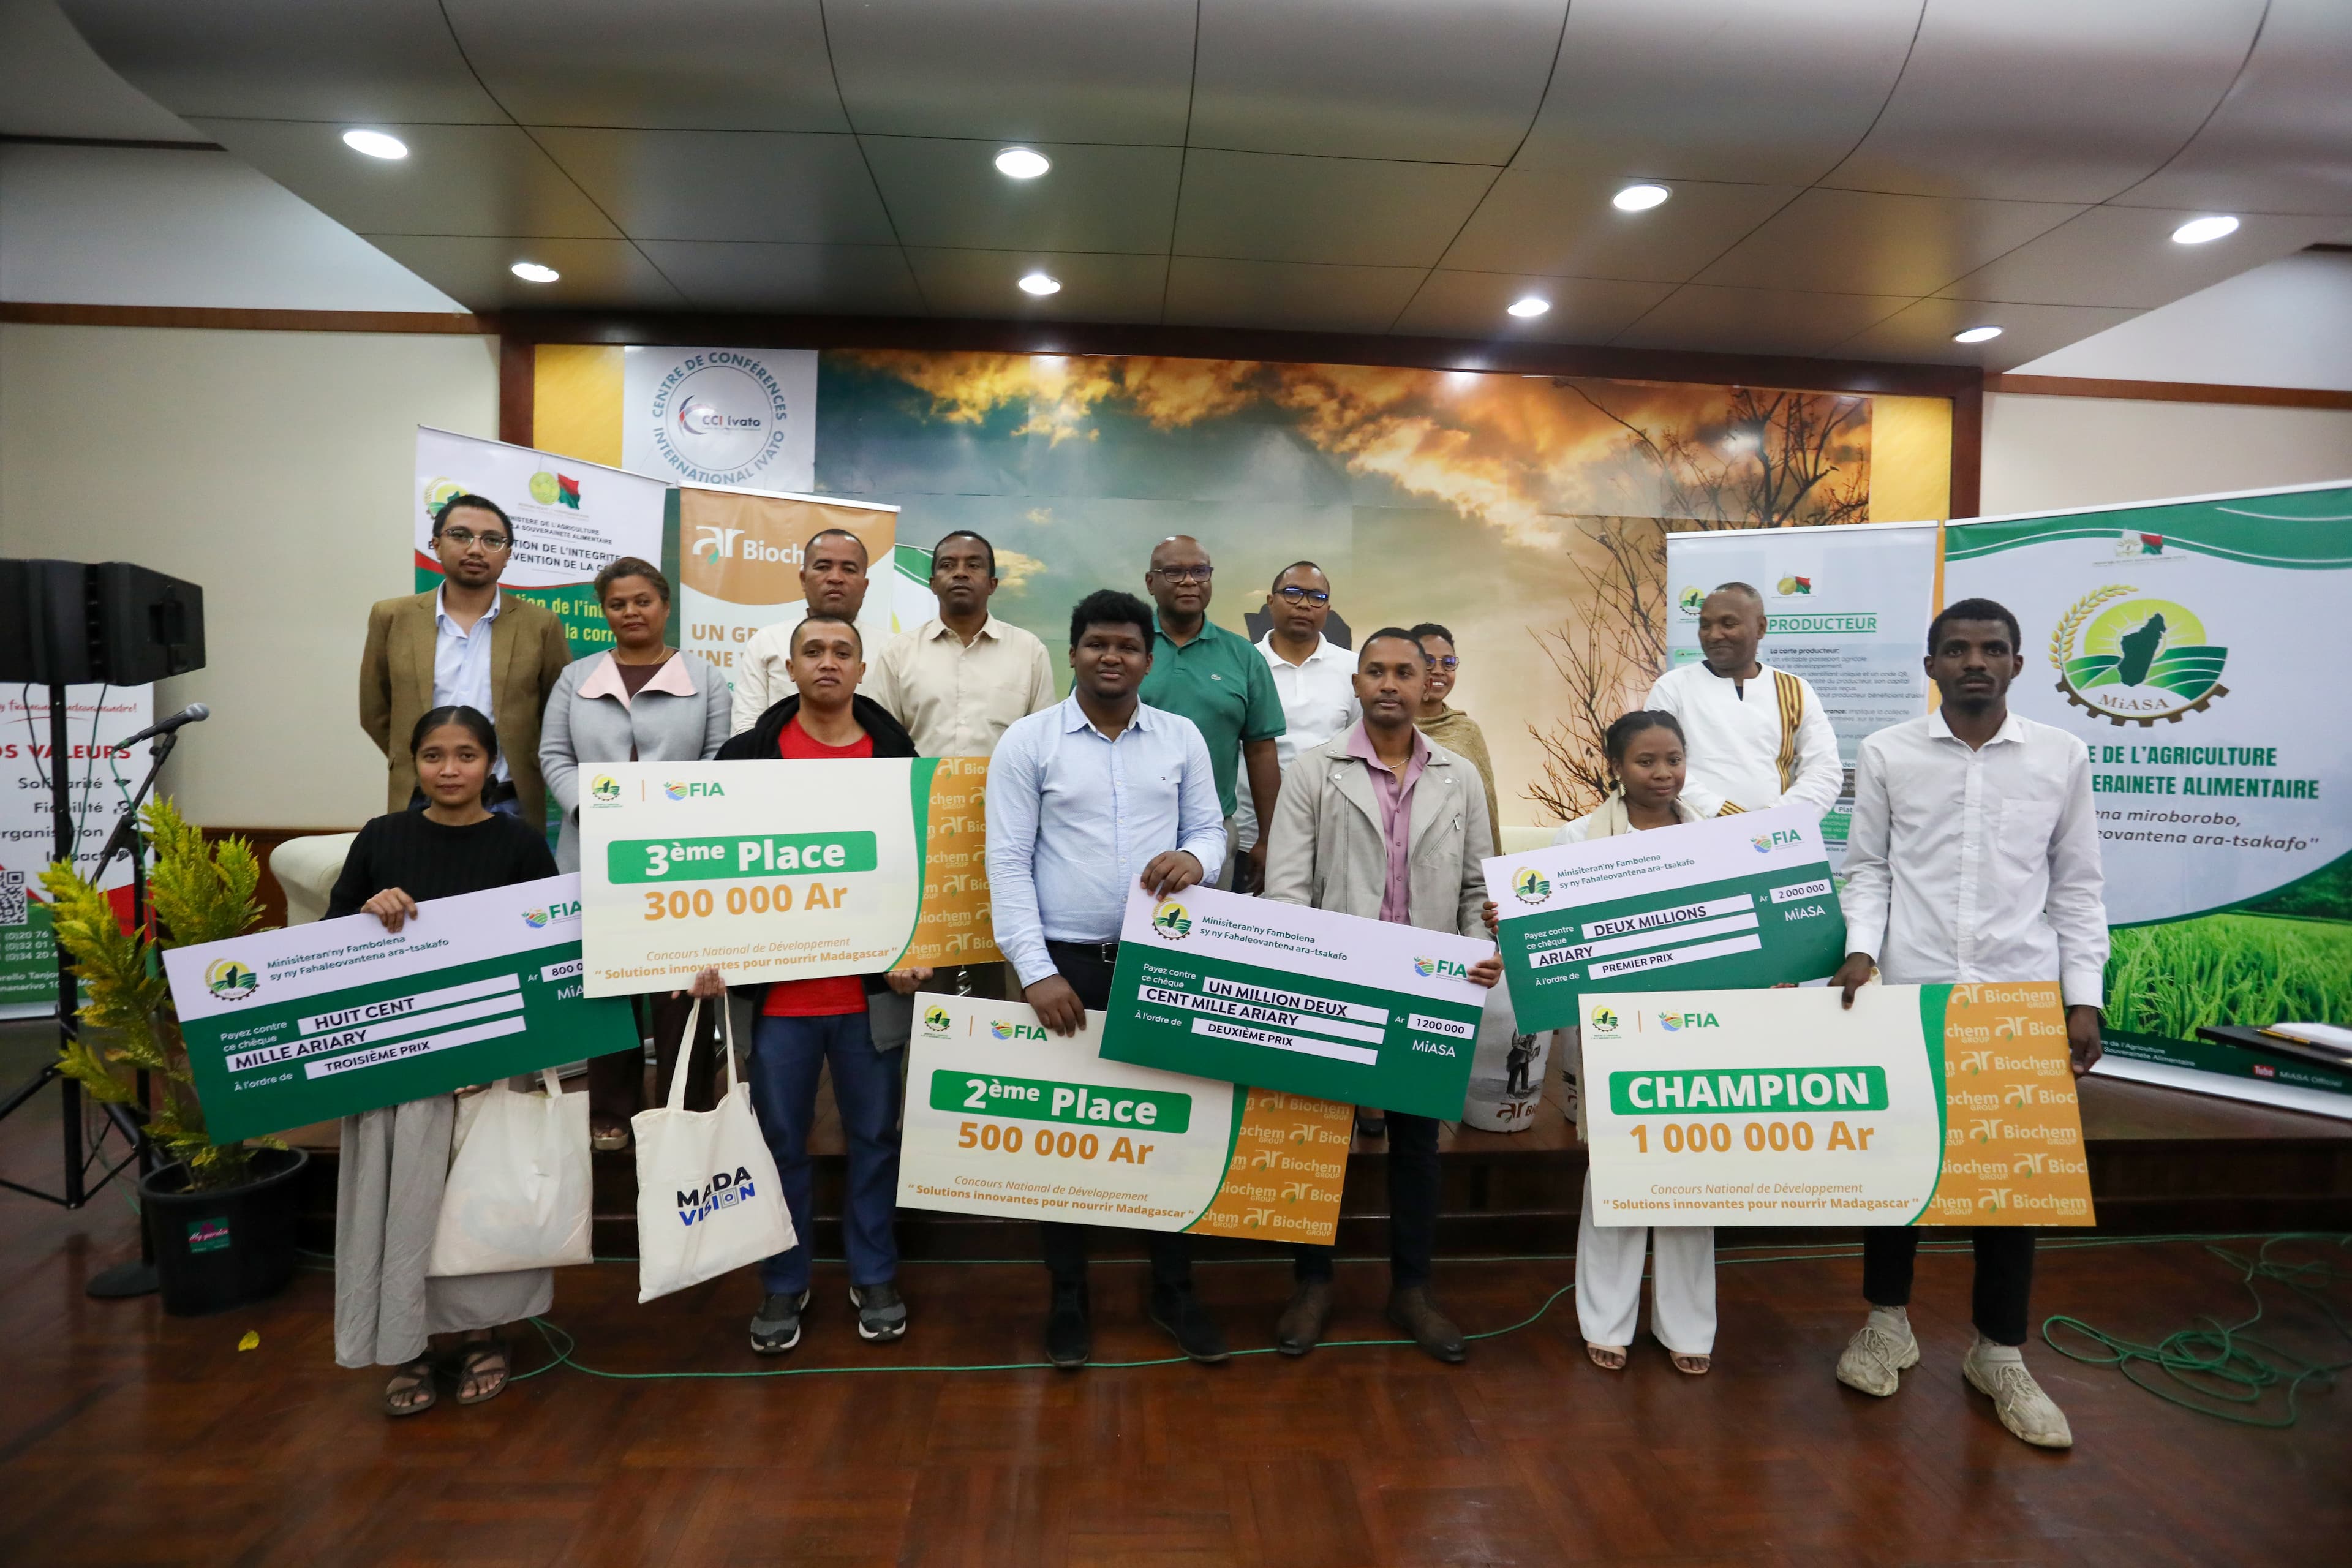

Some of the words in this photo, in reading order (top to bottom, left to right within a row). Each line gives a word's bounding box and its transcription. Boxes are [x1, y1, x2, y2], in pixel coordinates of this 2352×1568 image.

[652, 368, 684, 417] CENTRE
[684, 355, 704, 371] DE
[709, 352, 786, 420] CONFÉRENCES
[703, 415, 723, 426] CCI
[653, 427, 754, 484] INTERNATIONAL
[754, 431, 784, 470] IVATO
[522, 526, 571, 538] SOUVERAINETE
[572, 534, 612, 545] ALIMENTAIRE
[552, 522, 600, 535] L'AGRICULTURE
[543, 544, 557, 552] DE
[743, 540, 805, 564] Bioch
[564, 560, 576, 568] DE
[581, 562, 594, 571] LA
[552, 598, 569, 614] de
[565, 623, 578, 639] la
[692, 624, 724, 641] UN
[1769, 617, 1877, 631] PRODUCTEUR
[2103, 745, 2124, 764] DE
[2131, 746, 2277, 766] L'AGRICULTURE
[690, 782, 725, 797] FIA
[2092, 774, 2176, 794] ERAINETE
[2183, 777, 2320, 799] ALIMENTAIRE
[2127, 811, 2241, 827] miroborobo,
[1771, 829, 1802, 845] FIA
[644, 843, 725, 876] 3ème
[738, 839, 845, 872] Place
[1558, 864, 1615, 878] Minisiteran'ny
[1616, 854, 1661, 869] Fambolena
[1581, 867, 1646, 884] Fahaleovantena
[1648, 859, 1695, 873] ara-tsakafo
[1786, 888, 1804, 897] 000
[1807, 884, 1825, 893] 000
[549, 900, 582, 919] FIA
[644, 889, 714, 921] 300
[727, 884, 793, 915] 000
[804, 882, 848, 910] Ar
[1202, 916, 1265, 935] Minisiteran'ny
[1267, 928, 1315, 943] Fambolena
[1594, 919, 1636, 937] DEUX
[1638, 906, 1706, 929] MILLIONS
[1525, 931, 1547, 941] Payez
[1548, 925, 1574, 937] contre
[1538, 937, 1567, 949] chèque
[267, 947, 344, 969] Minisiteran'ny
[347, 935, 405, 954] Fambolena
[646, 949, 699, 962] Concours
[702, 944, 750, 957] National
[753, 942, 766, 954] de
[769, 937, 850, 955] Développement
[1225, 932, 1294, 951] Fahaleovantena
[1295, 945, 1348, 961] ara-tsakafo
[1539, 946, 1593, 966] ARIARY
[284, 970, 297, 979] ny
[300, 952, 386, 976] Fahaleovantena
[388, 938, 449, 957] ara-tsakafo
[605, 967, 666, 979] Solutions
[669, 960, 740, 974] innovantes
[744, 957, 772, 970] pour
[775, 952, 818, 965] nourrir
[820, 948, 889, 964] Madagascar
[1602, 959, 1648, 973] PREMIER
[1650, 953, 1673, 965] PRIX
[528, 973, 538, 982] Ar
[552, 966, 573, 976] 800
[1144, 963, 1167, 975] Payez
[1170, 968, 1196, 980] contre
[1437, 960, 1467, 978] FIA
[1536, 978, 1542, 986] À
[1544, 974, 1568, 984] l'ordre
[1570, 972, 1580, 981] de
[1153, 976, 1184, 988] chèque
[1208, 981, 1232, 996] UN
[1235, 986, 1300, 1009] MILLION
[1304, 998, 1348, 1017] DEUX
[1985, 989, 2056, 1003] Biochem
[315, 1009, 361, 1030] HUIT
[365, 998, 415, 1019] CENT
[1147, 989, 1189, 1006] CENT
[1192, 997, 1237, 1016] MILLE
[1239, 1006, 1298, 1026] ARIARY
[1134, 1010, 1142, 1019] À
[1143, 1012, 1169, 1024] l'ordre
[1170, 1017, 1182, 1027] de
[1444, 1023, 1464, 1034] 000
[1684, 1013, 1719, 1028] FIA
[1014, 1024, 1048, 1042] FIA
[1208, 1023, 1265, 1041] DEUXIÈME
[1268, 1035, 1293, 1046] PRIX
[235, 1046, 292, 1069] MILLE
[296, 1030, 367, 1057] ARIARY
[324, 1047, 398, 1072] TROISIÈME
[401, 1041, 430, 1055] PRIX
[1628, 1073, 1869, 1109] CHAMPION
[963, 1079, 1040, 1109] 2ème
[1051, 1087, 1158, 1125] Place
[958, 1121, 1023, 1153] 500
[1035, 1129, 1099, 1160] 000
[1109, 1137, 1154, 1165] Ar
[1630, 1124, 1648, 1153] 1
[1664, 1123, 1731, 1153] 000
[1744, 1121, 1814, 1152] 000
[1827, 1120, 1874, 1152] Ar
[1281, 1157, 1341, 1172] Biochem
[677, 1167, 752, 1207] MADA
[955, 1175, 1003, 1190] Concours
[1006, 1180, 1050, 1194] National
[1053, 1183, 1066, 1194] de
[1068, 1185, 1148, 1202] Développement
[1651, 1184, 1702, 1195] Concours
[1705, 1183, 1754, 1194] National
[1757, 1183, 1771, 1194] de
[1774, 1182, 1863, 1197] Développement
[679, 1182, 755, 1226] VISION
[916, 1185, 971, 1199] Solutions
[974, 1190, 1039, 1205] innovantes
[1042, 1198, 1069, 1209] pour
[1072, 1200, 1114, 1212] nourrir
[1116, 1203, 1186, 1219] Madagascar
[1613, 1199, 1670, 1210] Solutions
[1674, 1198, 1744, 1209] innovantes
[1748, 1200, 1777, 1212] pour
[1781, 1197, 1828, 1208] nourrir
[1831, 1197, 1909, 1210] Madagascar
